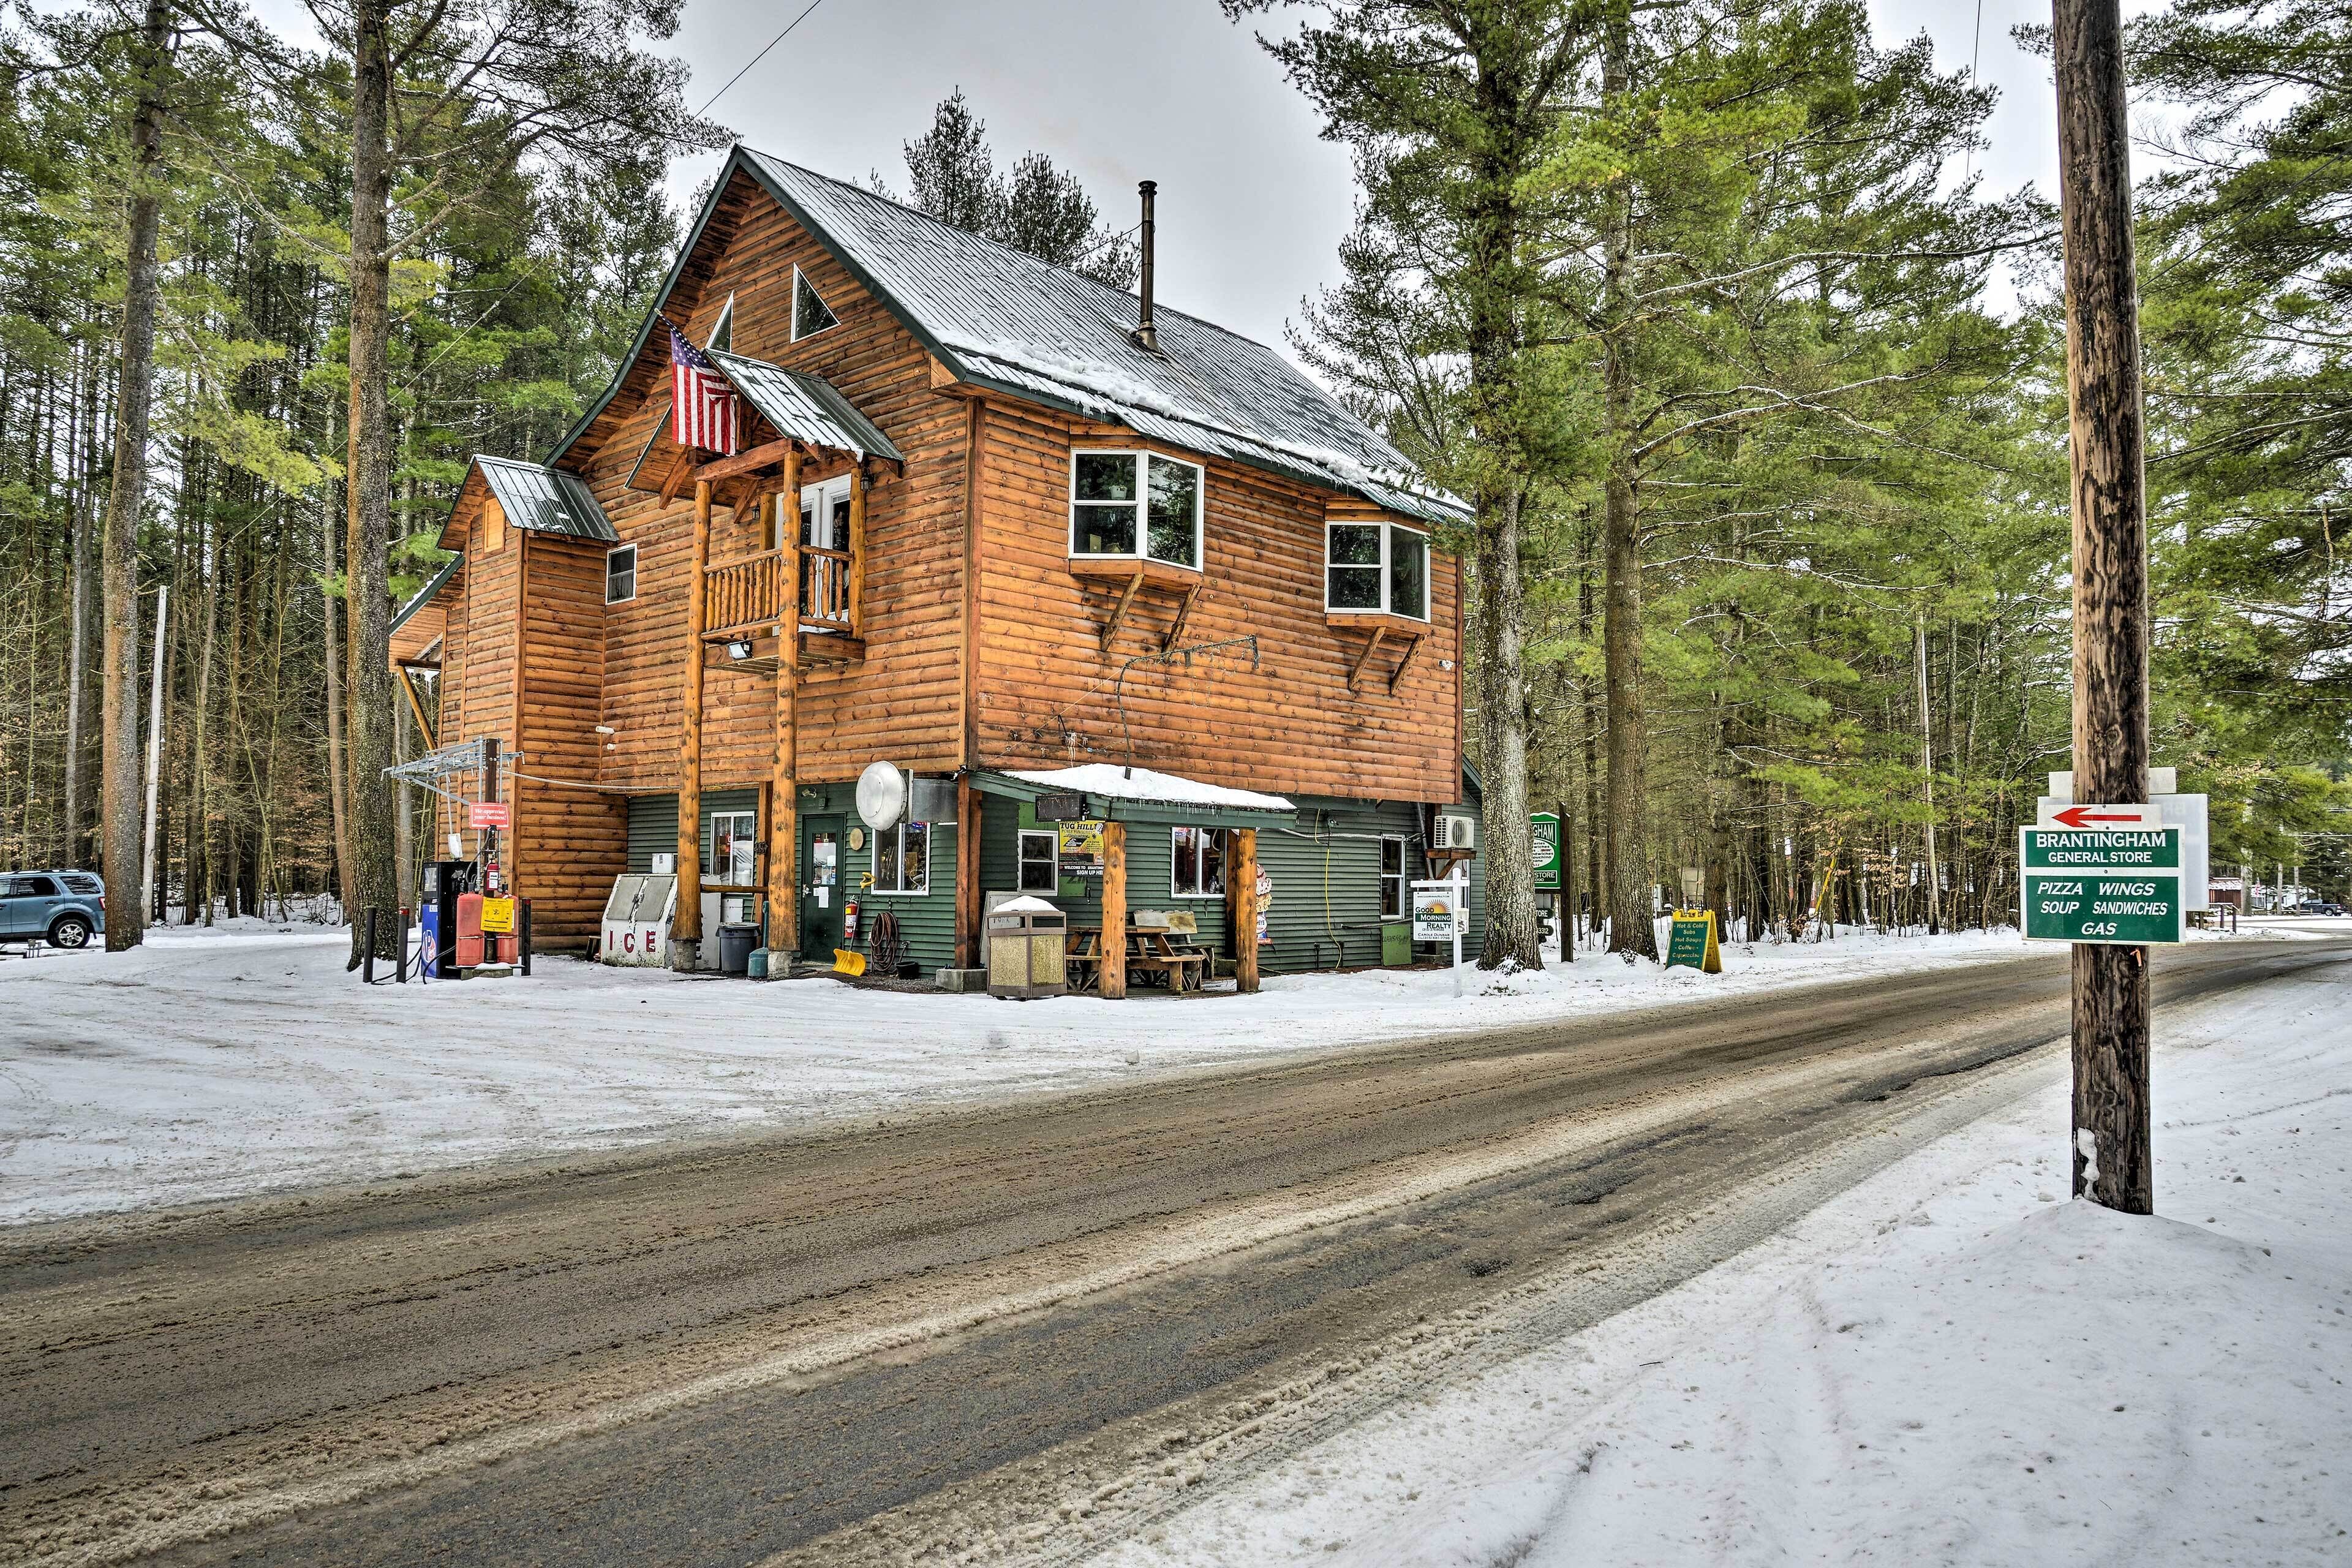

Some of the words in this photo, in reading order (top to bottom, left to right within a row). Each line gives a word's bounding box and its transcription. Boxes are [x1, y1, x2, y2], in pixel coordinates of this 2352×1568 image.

[2037, 832, 2166, 848] BRANTINGHAM
[2048, 852, 2108, 862] GENERAL
[2110, 851, 2152, 862] STORE
[2037, 882, 2083, 895] PIZZA
[2098, 883, 2156, 896] WINGS
[2040, 901, 2079, 914] SOUP
[2092, 901, 2168, 916] SANDWICHES
[2081, 922, 2117, 935] GAS
[609, 930, 657, 954] ICE
